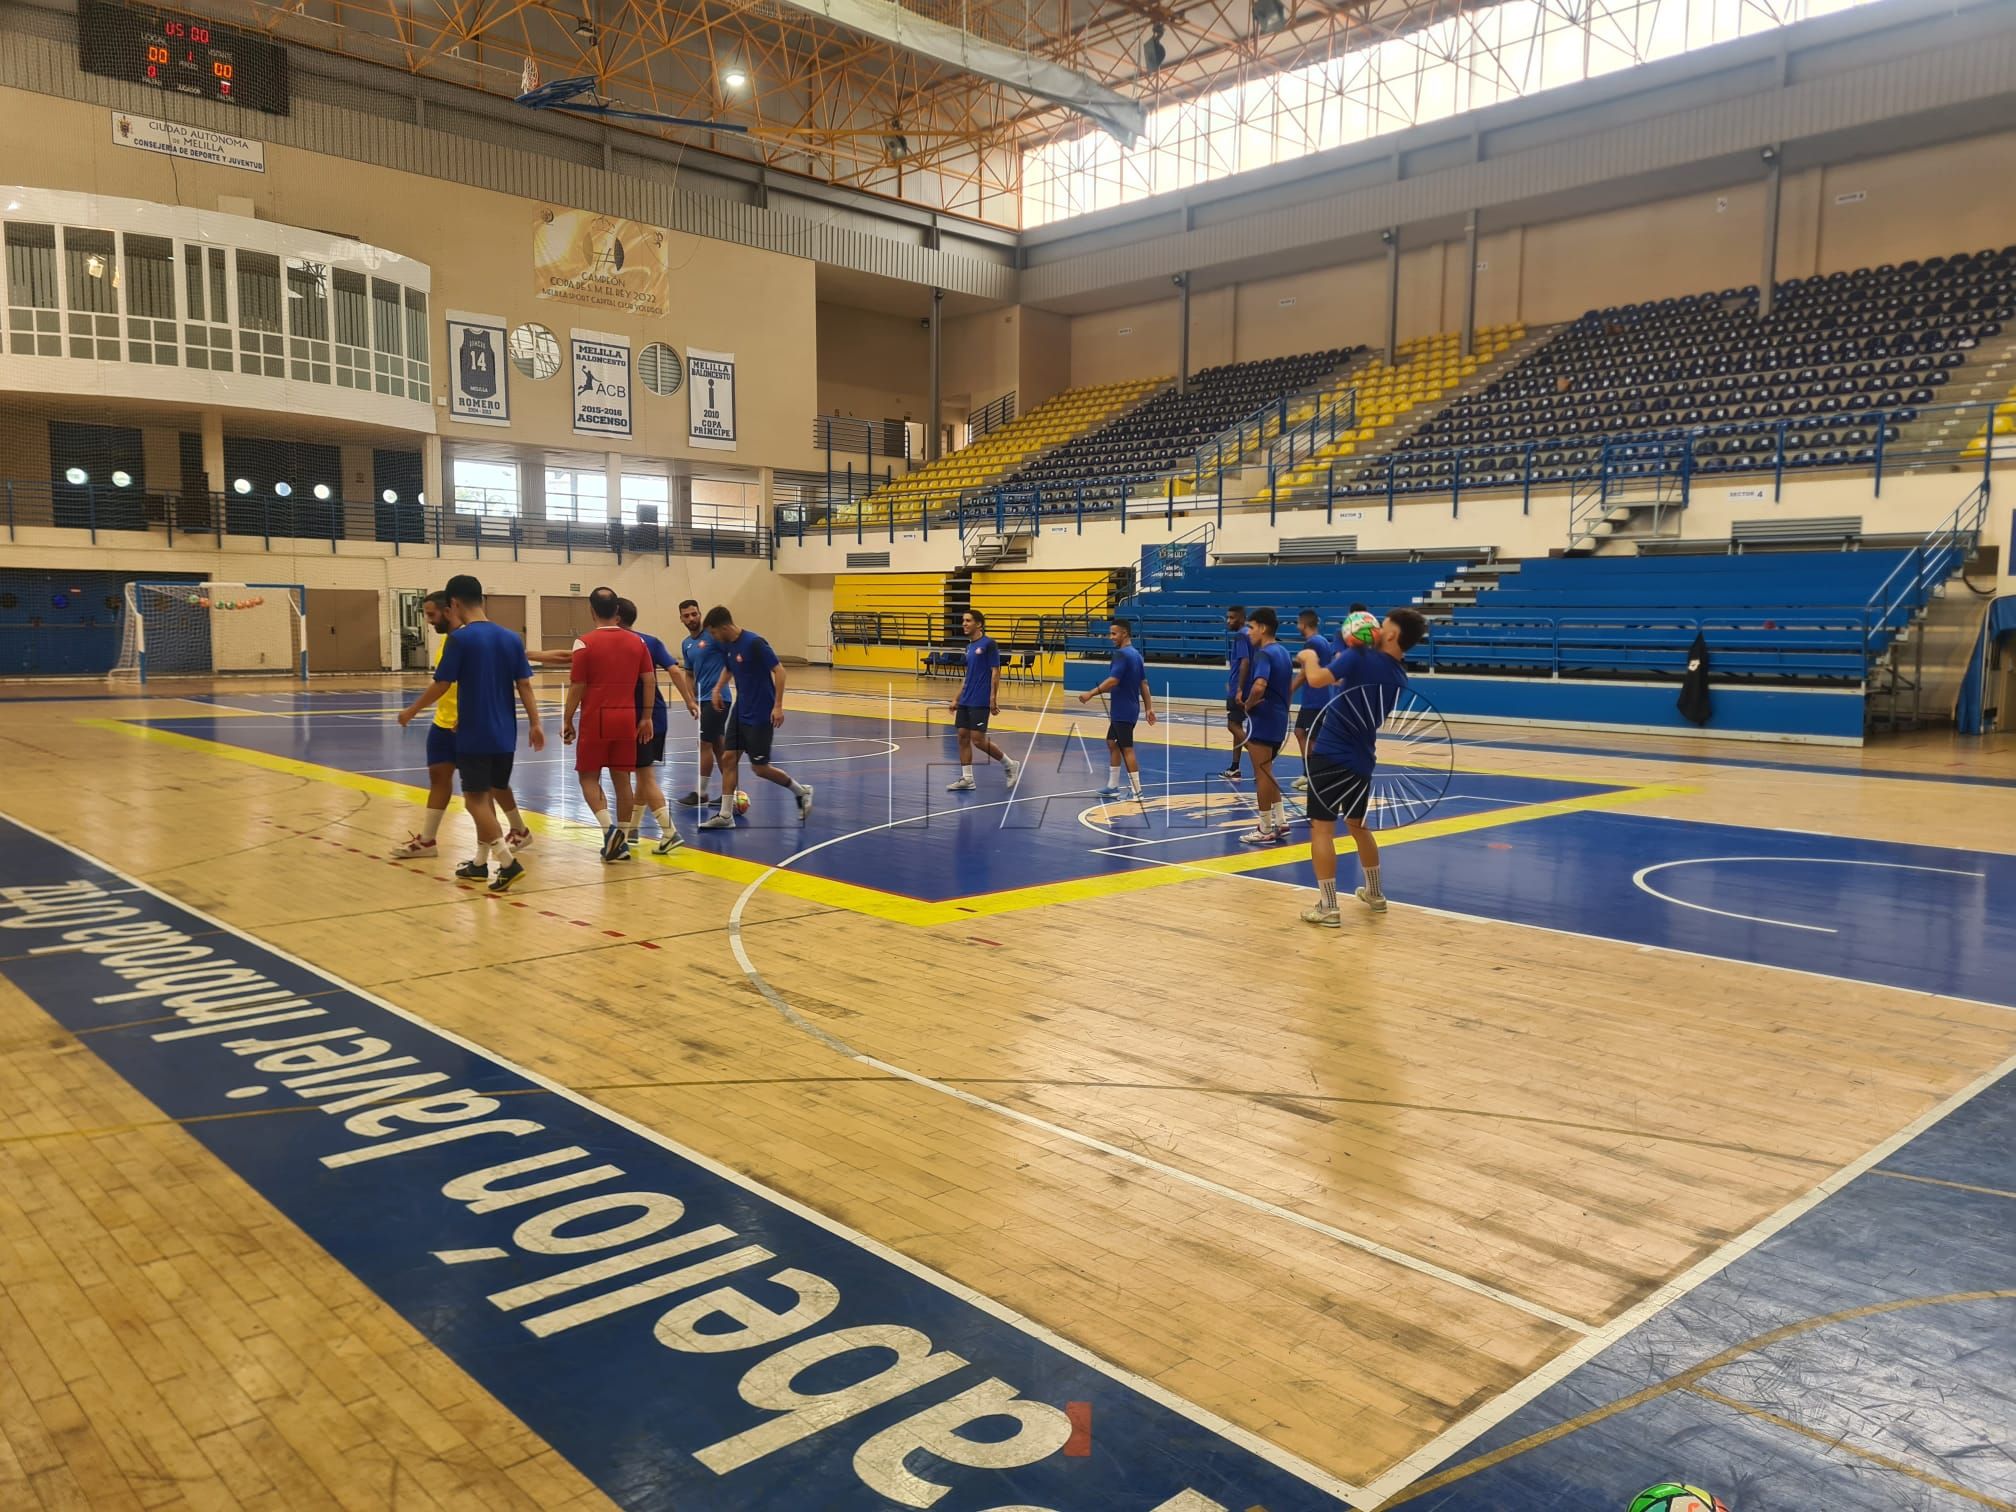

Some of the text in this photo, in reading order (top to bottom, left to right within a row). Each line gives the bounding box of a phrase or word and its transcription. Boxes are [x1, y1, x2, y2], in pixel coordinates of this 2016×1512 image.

[148, 46, 168, 64] 00
[213, 62, 232, 79] 00
[149, 121, 188, 137] CIUDAD
[183, 137, 224, 153] MELILLA
[179, 146, 189, 155] DE
[190, 149, 221, 162] DEPORTE
[228, 158, 263, 170] JUVENTUD
[550, 276, 574, 289] COPA
[633, 291, 656, 303] 2022
[578, 345, 623, 359] MELILLA
[470, 350, 487, 371] 14
[576, 353, 626, 367] BALONCESTO
[693, 361, 729, 373] MELILLA
[691, 368, 730, 380] BALONCESTO
[596, 383, 626, 398] ACB
[458, 397, 500, 410] ROMERO
[581, 405, 622, 416] 2015-2016
[577, 413, 628, 427] ASCENSO
[703, 409, 719, 419] 2010
[702, 420, 722, 429] COPA
[28, 920, 329, 1043] Imbroda
[222, 1027, 546, 1169] Javier
